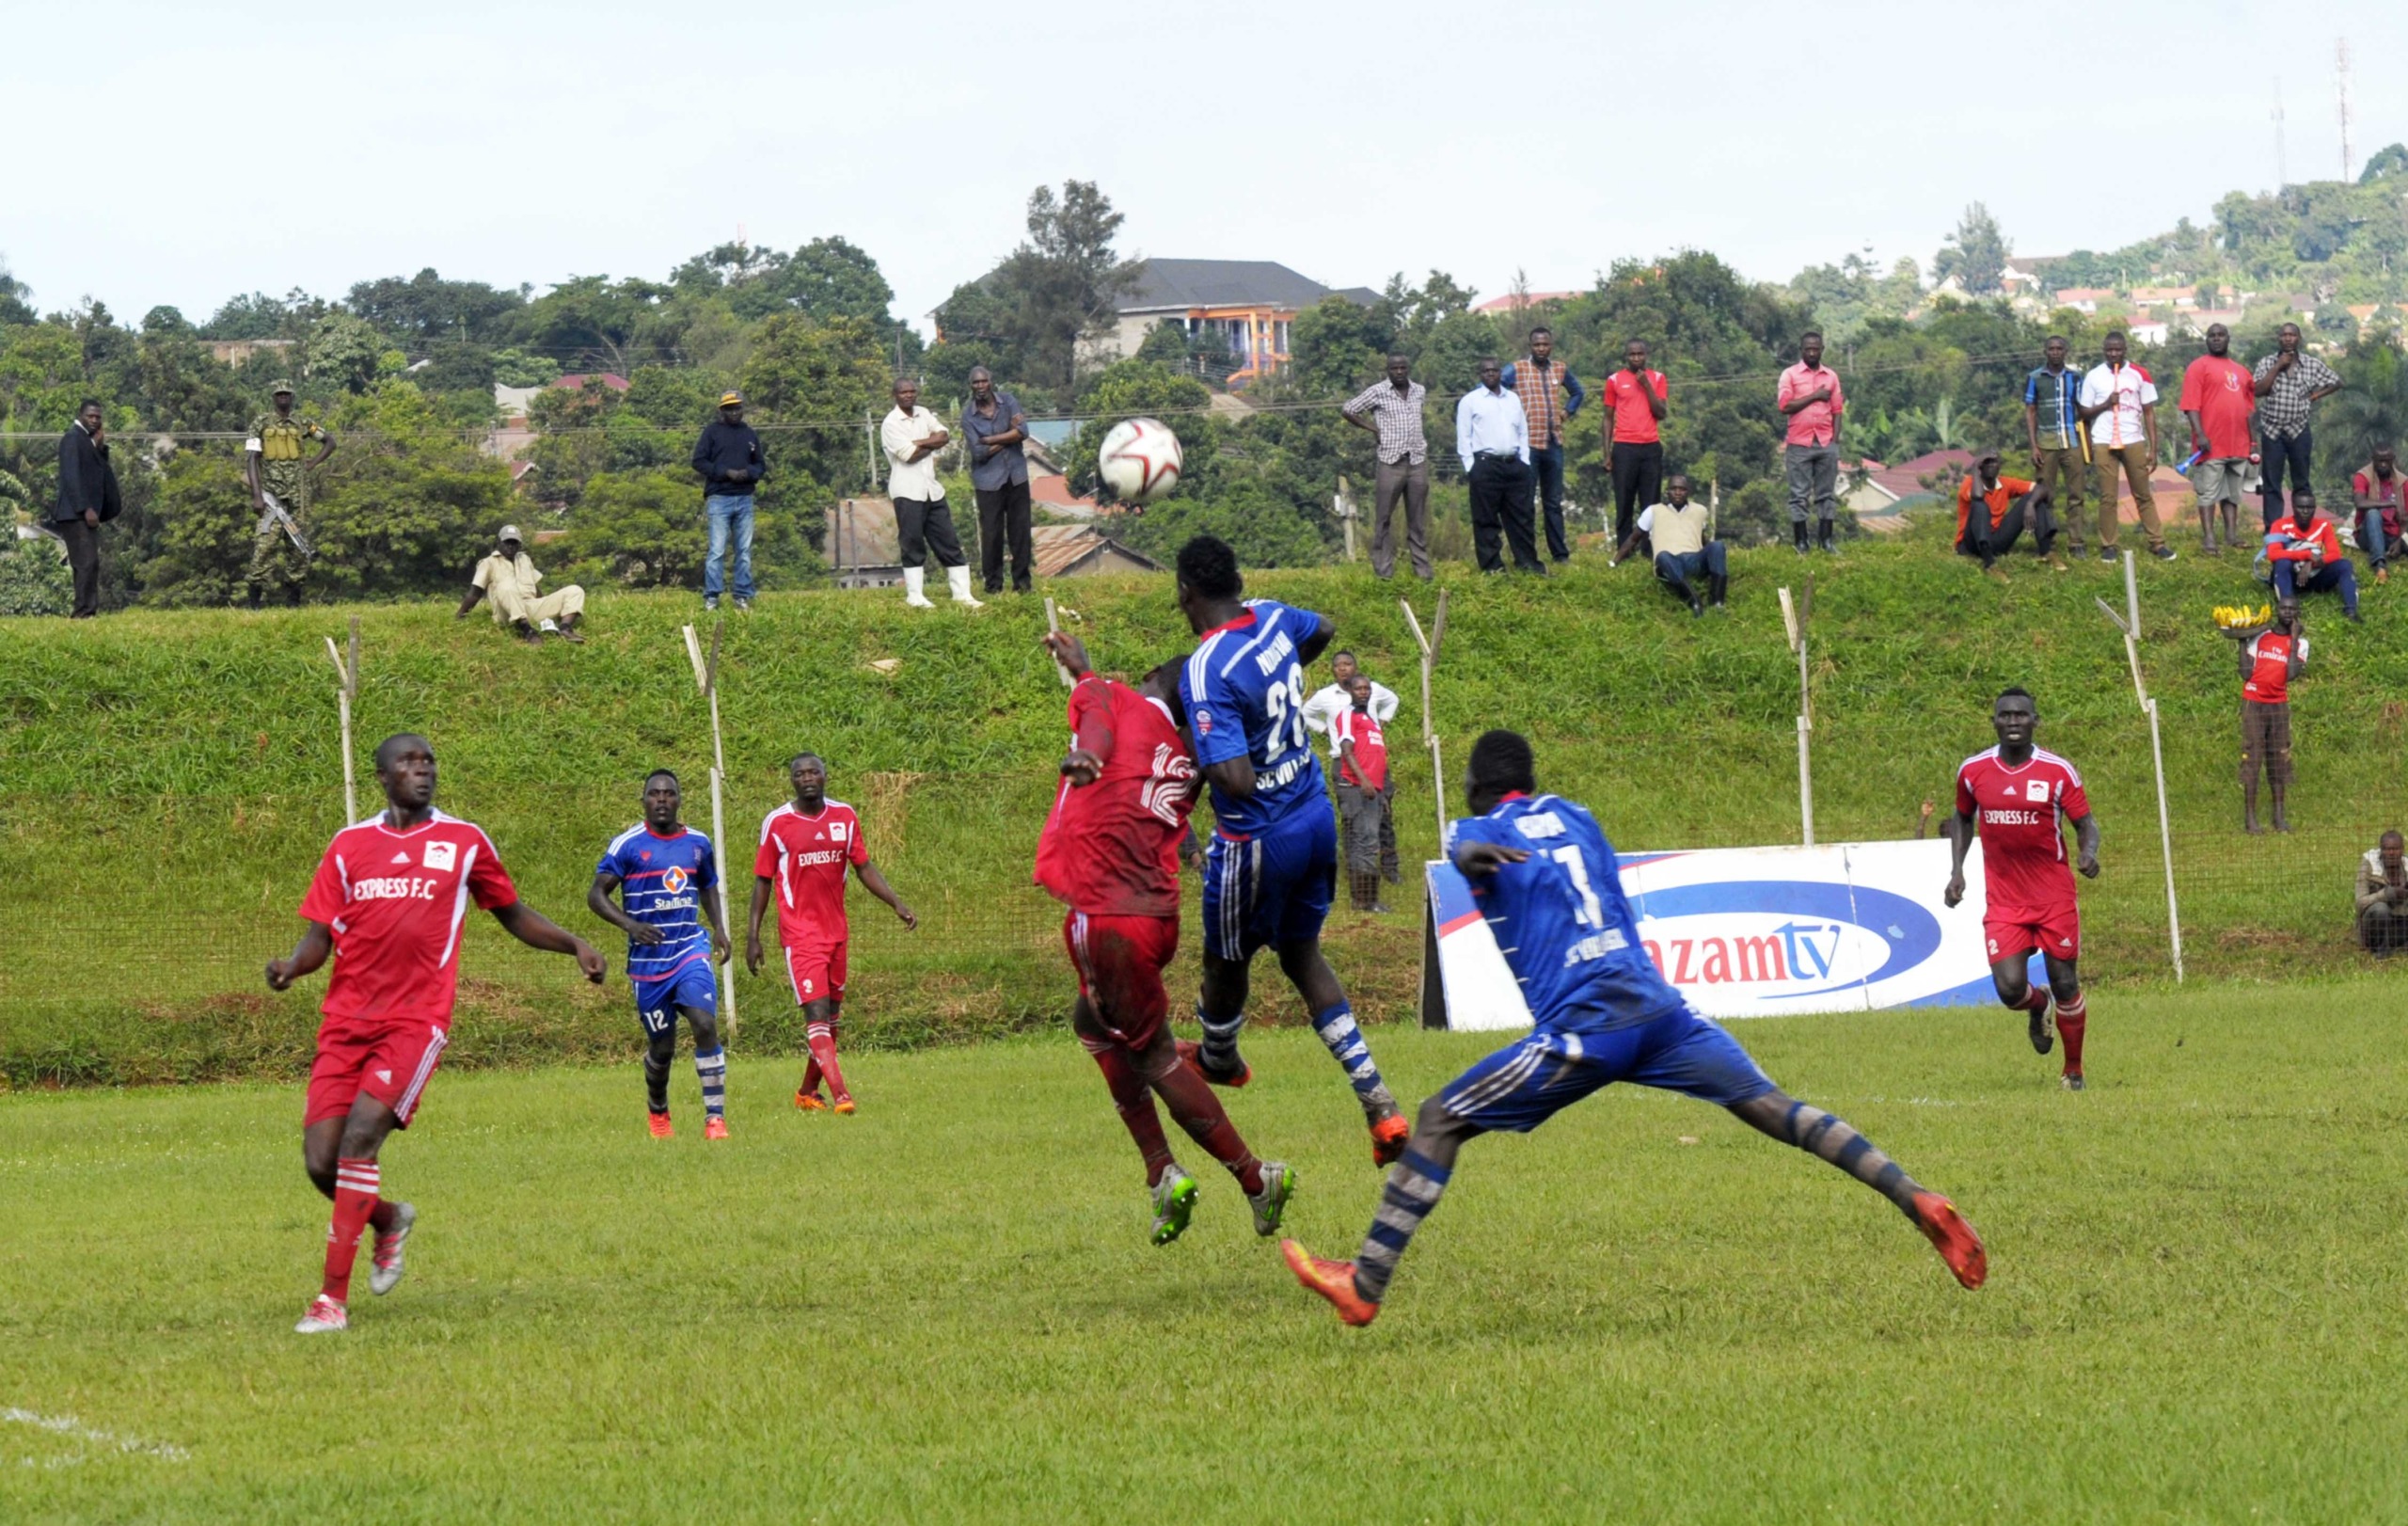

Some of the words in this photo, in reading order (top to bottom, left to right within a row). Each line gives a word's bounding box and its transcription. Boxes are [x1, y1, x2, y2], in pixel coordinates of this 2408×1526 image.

[1140, 741, 1198, 829] 12
[1984, 810, 2022, 825] EXPRESS
[799, 850, 831, 866] EXPRESS
[354, 878, 410, 901] EXPRESS
[410, 877, 437, 900] F.C
[1988, 938, 2000, 956] 2
[644, 1009, 669, 1033] 12
